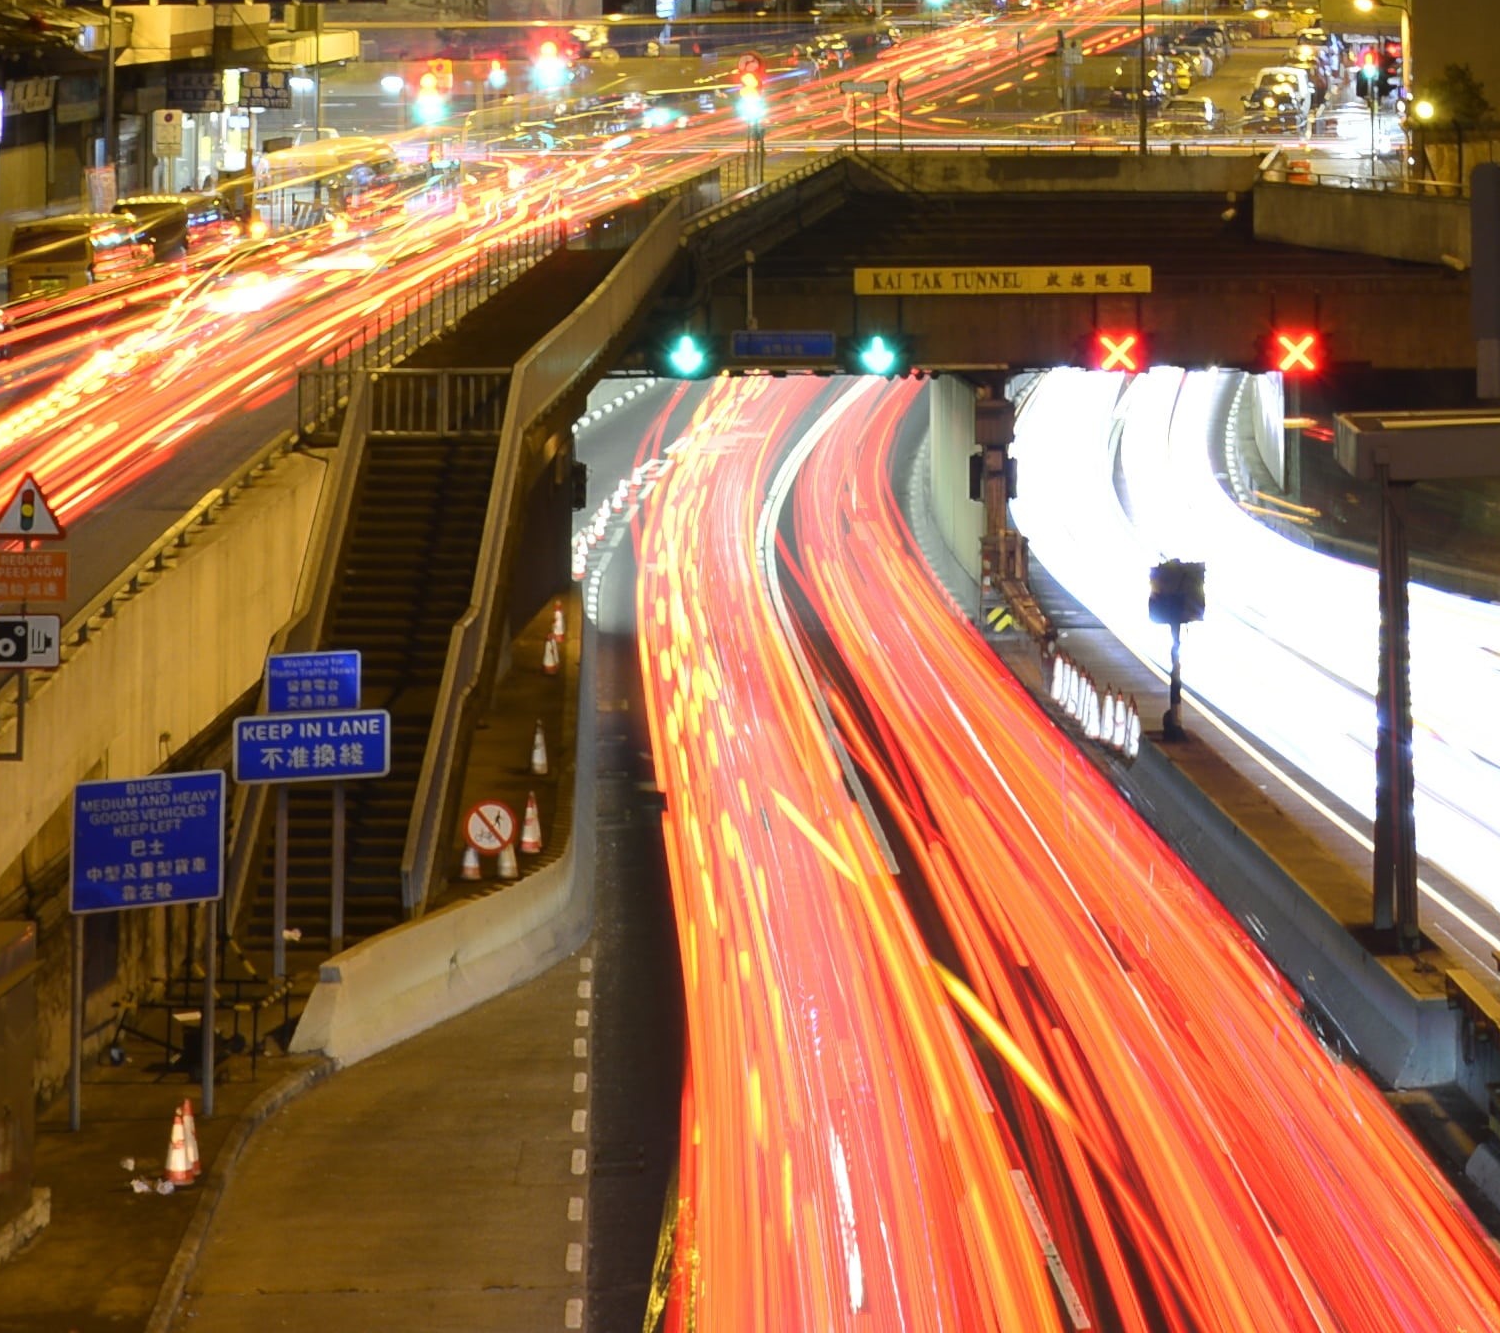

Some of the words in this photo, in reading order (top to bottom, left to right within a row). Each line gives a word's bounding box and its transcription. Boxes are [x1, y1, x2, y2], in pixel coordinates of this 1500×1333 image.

[872, 273, 902, 290] KAI
[911, 272, 943, 289] TAK
[952, 271, 1022, 289] TUNNEL
[0, 554, 53, 566] REDUCE
[32, 565, 65, 578] NOW
[242, 722, 294, 742] KEEP
[300, 721, 322, 738] IN
[327, 718, 381, 737] LANE
[126, 780, 173, 795] BUSES
[81, 796, 138, 812] MEDIUM
[140, 794, 170, 807] AND
[172, 790, 217, 803] HEAVY
[89, 811, 139, 826] GOODS
[142, 804, 206, 821] VEHICLES
[113, 823, 149, 838] KEEP
[150, 819, 183, 834] LEFT
[129, 839, 165, 857] 巴士
